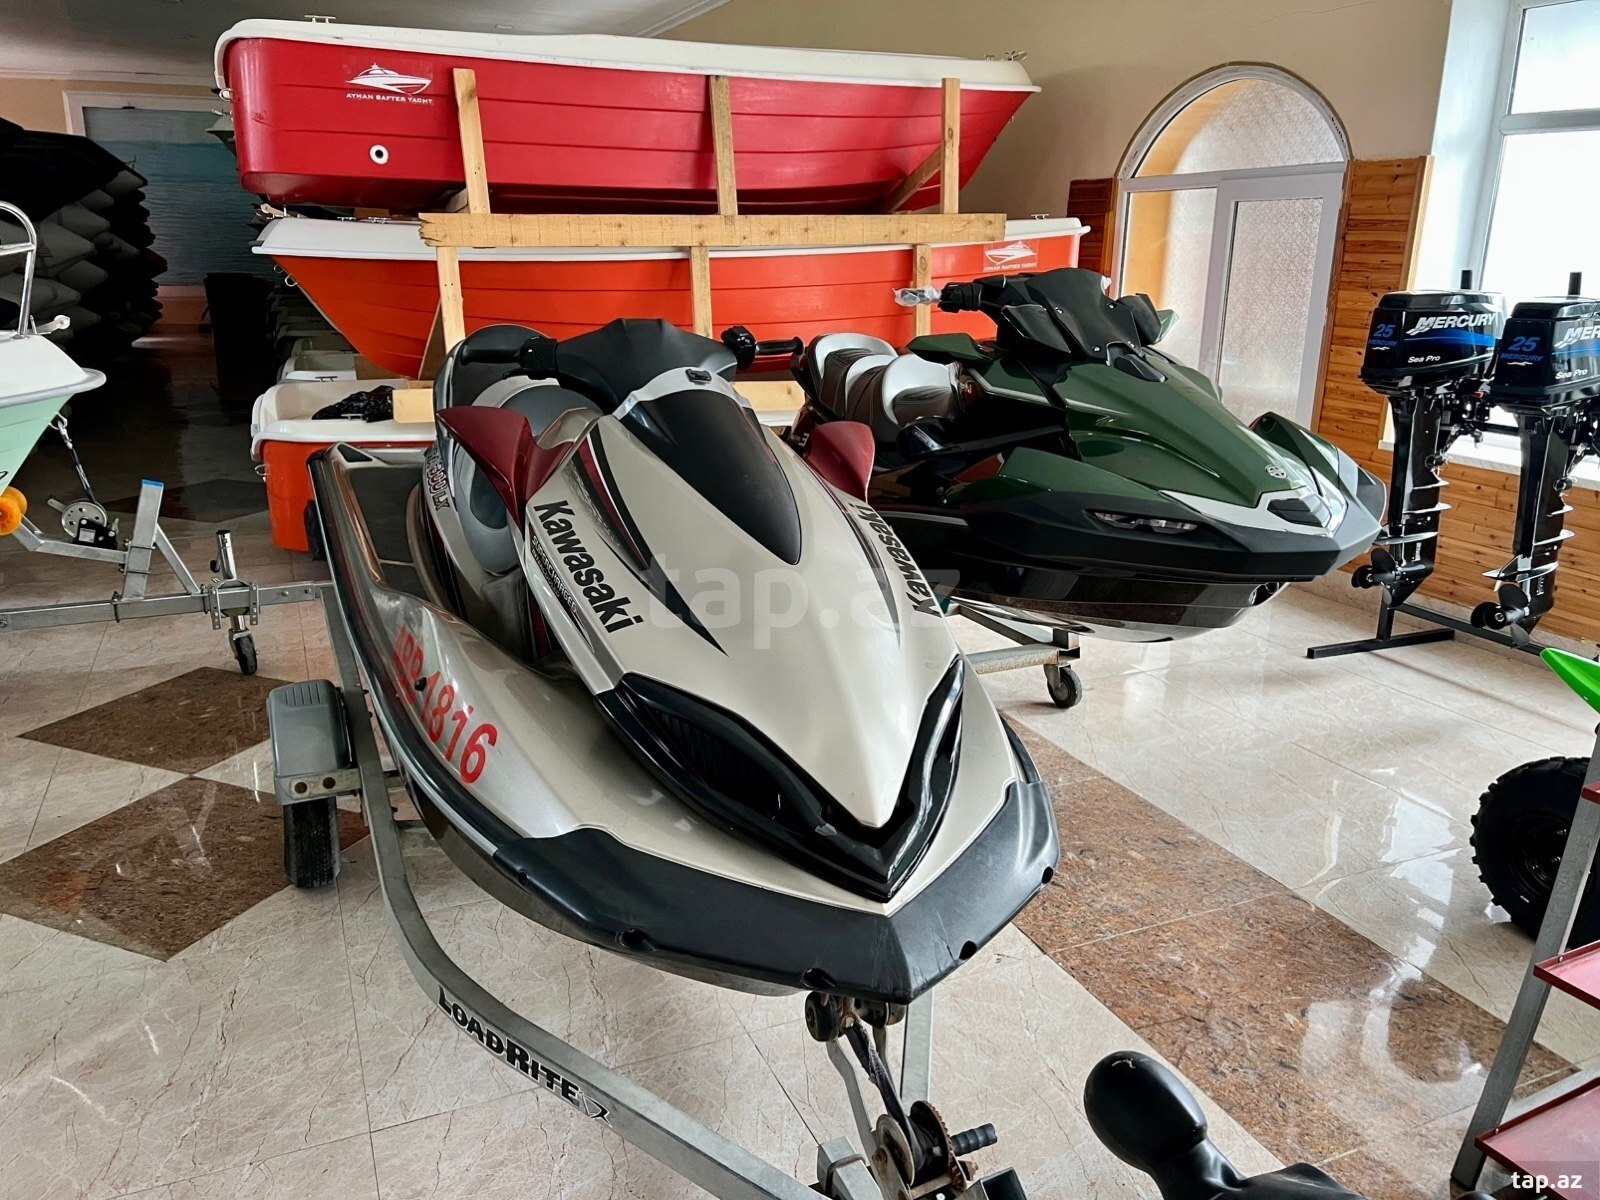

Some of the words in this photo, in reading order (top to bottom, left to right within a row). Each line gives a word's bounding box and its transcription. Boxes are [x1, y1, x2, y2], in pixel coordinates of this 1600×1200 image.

[1373, 323, 1395, 338] 25
[1406, 313, 1496, 336] MERCURY
[1368, 339, 1398, 347] MERCURY
[1508, 336, 1541, 351] 25
[1500, 353, 1544, 361] MERCURY
[1555, 371, 1573, 379] Sea
[534, 500, 644, 633] Kawasaki
[848, 502, 943, 619] Kawasaki
[531, 535, 577, 613] SUPERCHARGED
[438, 983, 580, 1107] LOADRITE
